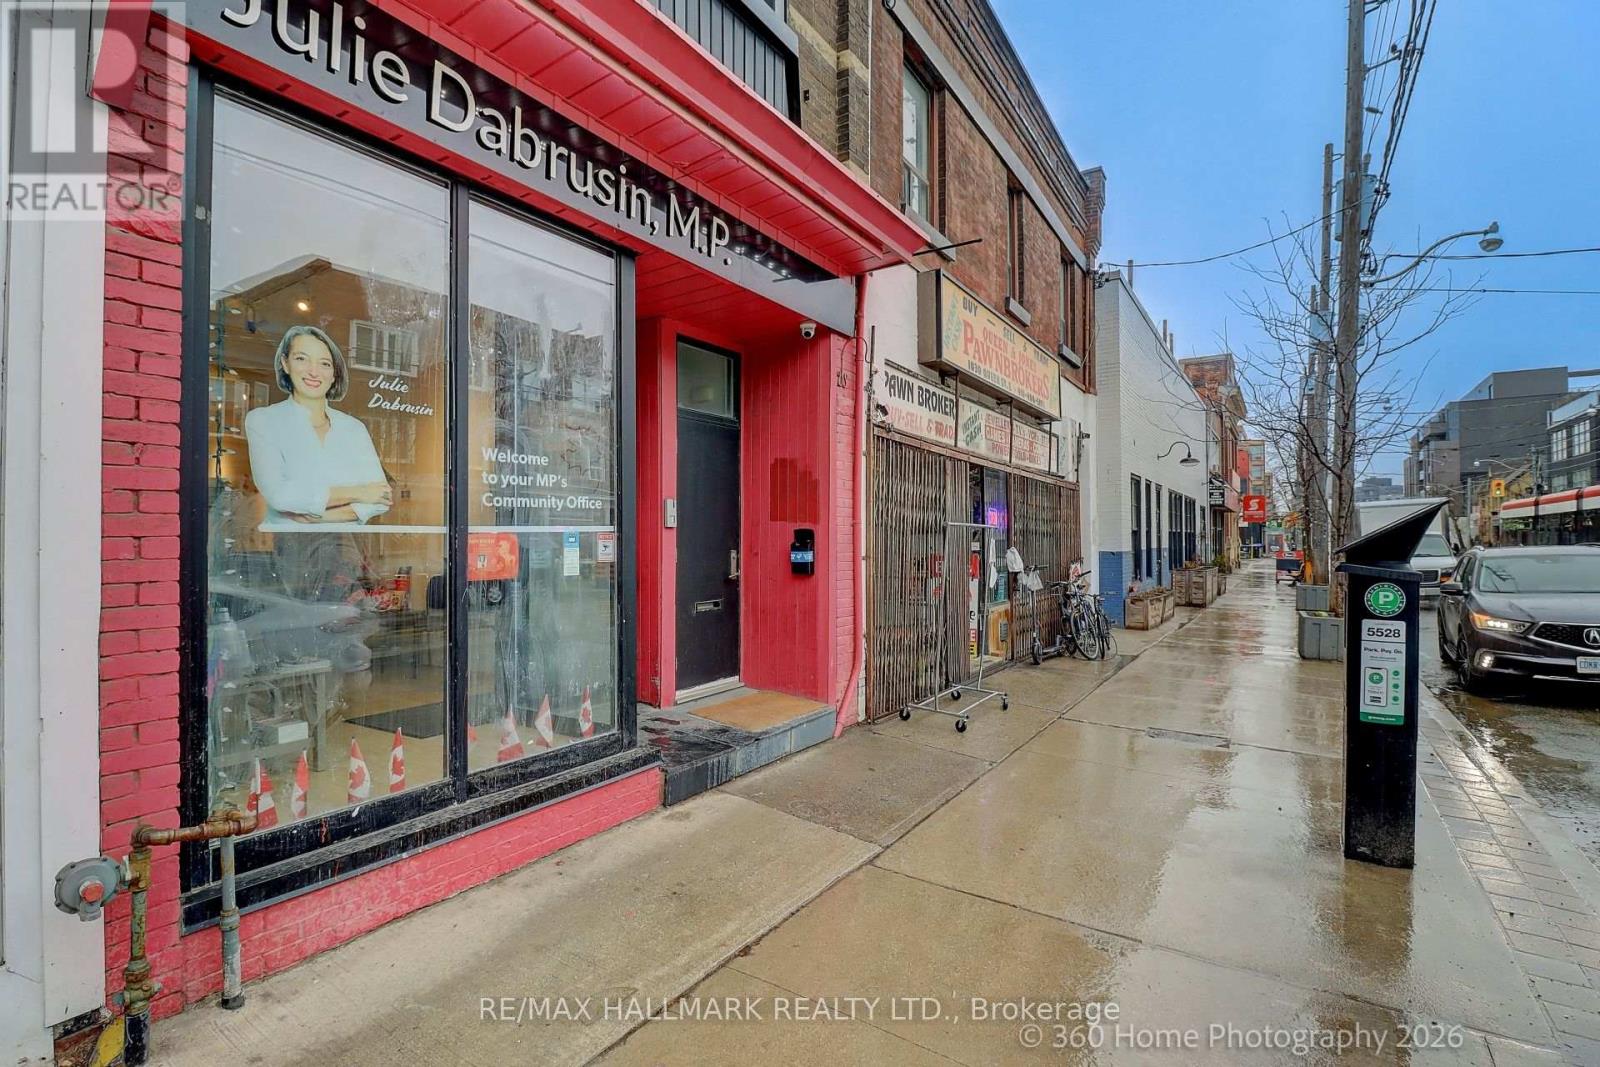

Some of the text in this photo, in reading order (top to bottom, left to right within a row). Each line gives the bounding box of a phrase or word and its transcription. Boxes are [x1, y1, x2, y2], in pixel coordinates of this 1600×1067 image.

[431, 59, 659, 235] Dabrusin,
[667, 192, 733, 266] M.P.
[963, 319, 1050, 400] PAWNBROKERS
[368, 374, 409, 394] Julie
[367, 393, 434, 417] Dabrusin
[482, 447, 550, 466] Welcome
[482, 472, 568, 489] to your MP's
[482, 493, 603, 512] Community Office
[1378, 591, 1395, 604] P
[1367, 627, 1401, 638] 5528
